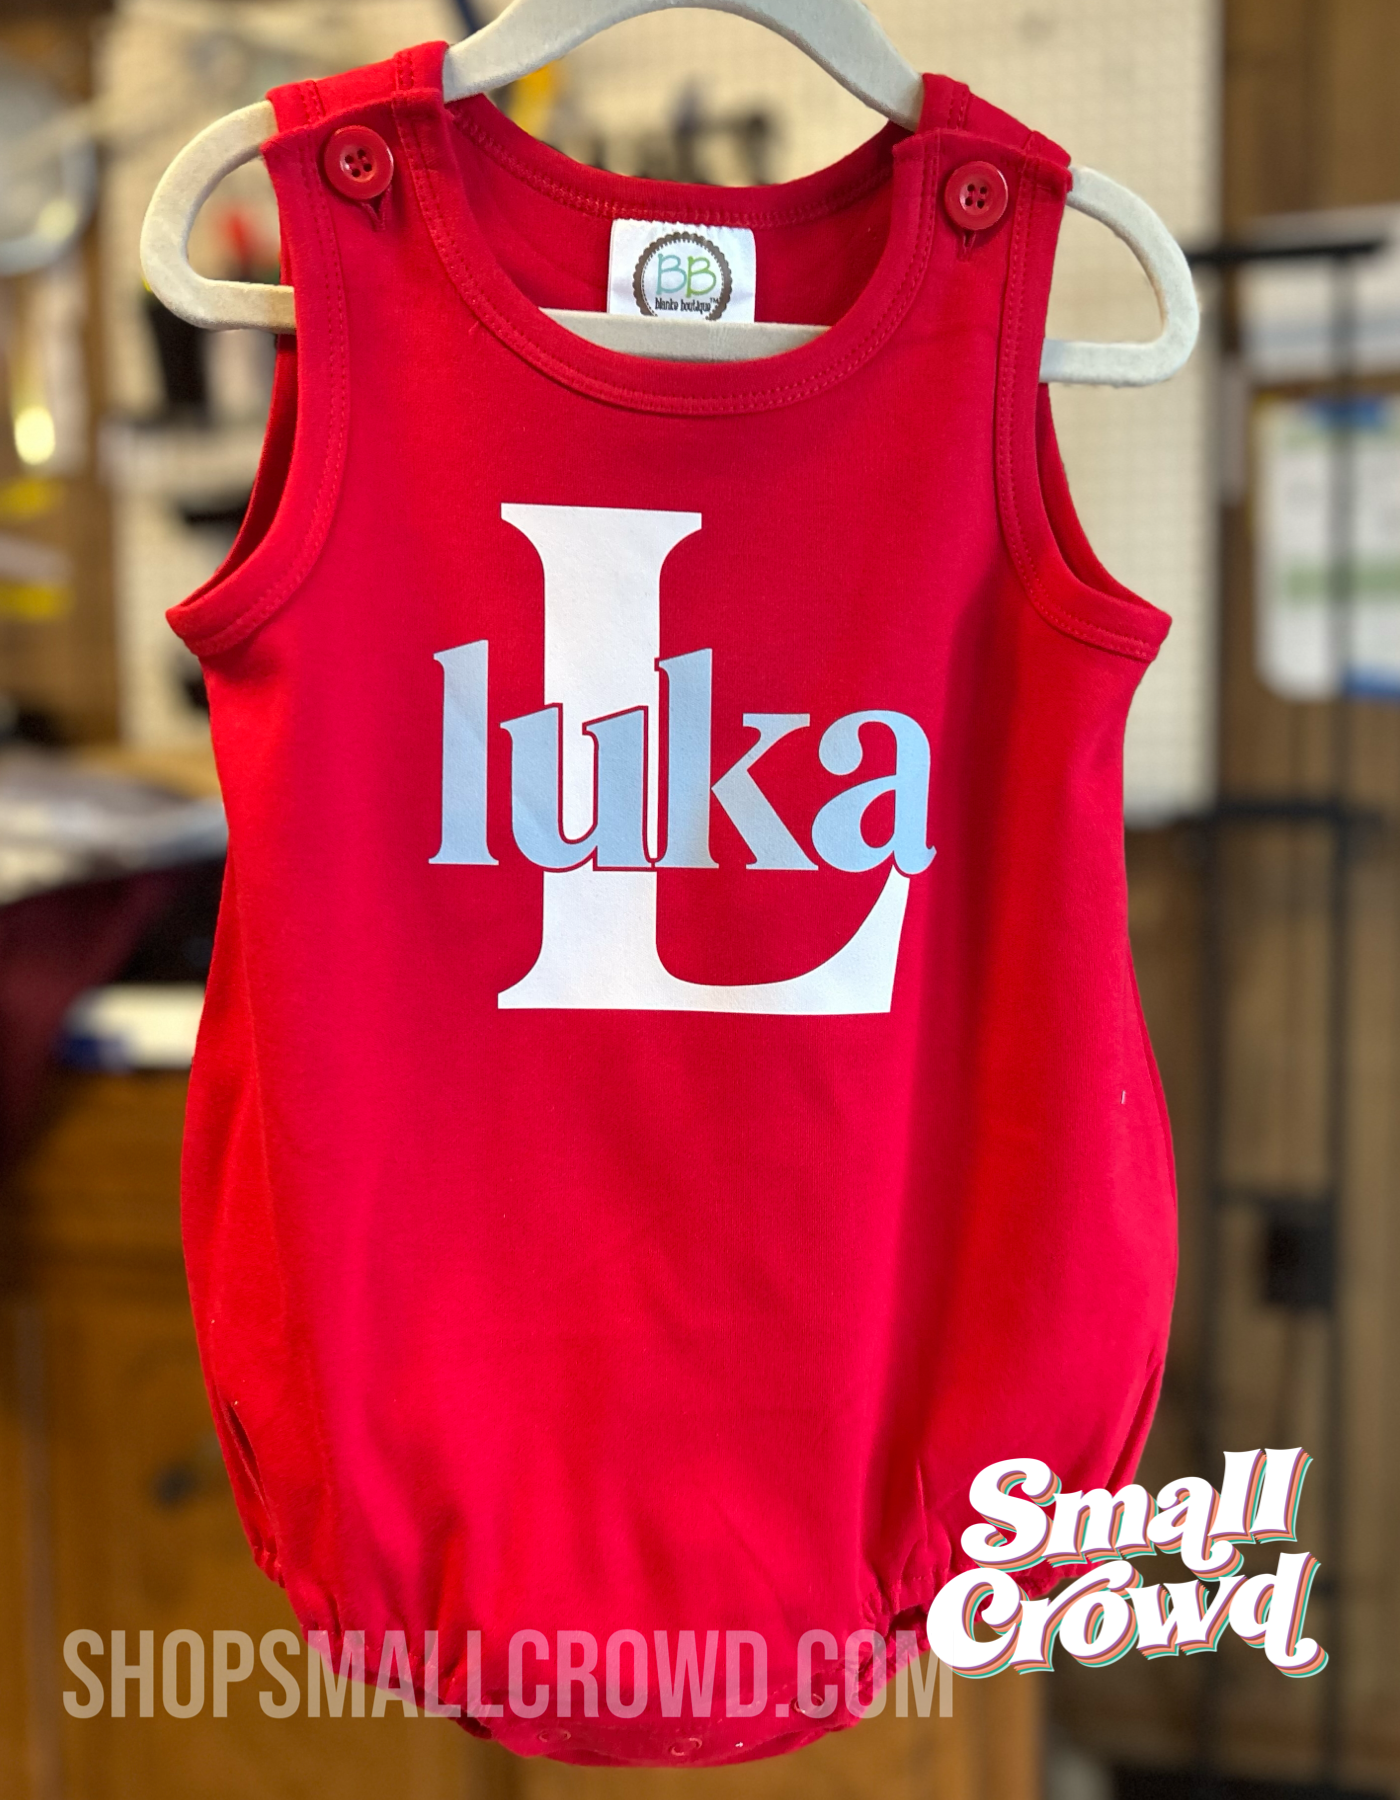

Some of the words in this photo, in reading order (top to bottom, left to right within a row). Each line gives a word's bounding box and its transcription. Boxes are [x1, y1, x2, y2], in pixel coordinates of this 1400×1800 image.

[656, 253, 717, 298] BB
[428, 640, 937, 875] luka
[498, 503, 910, 1015] L
